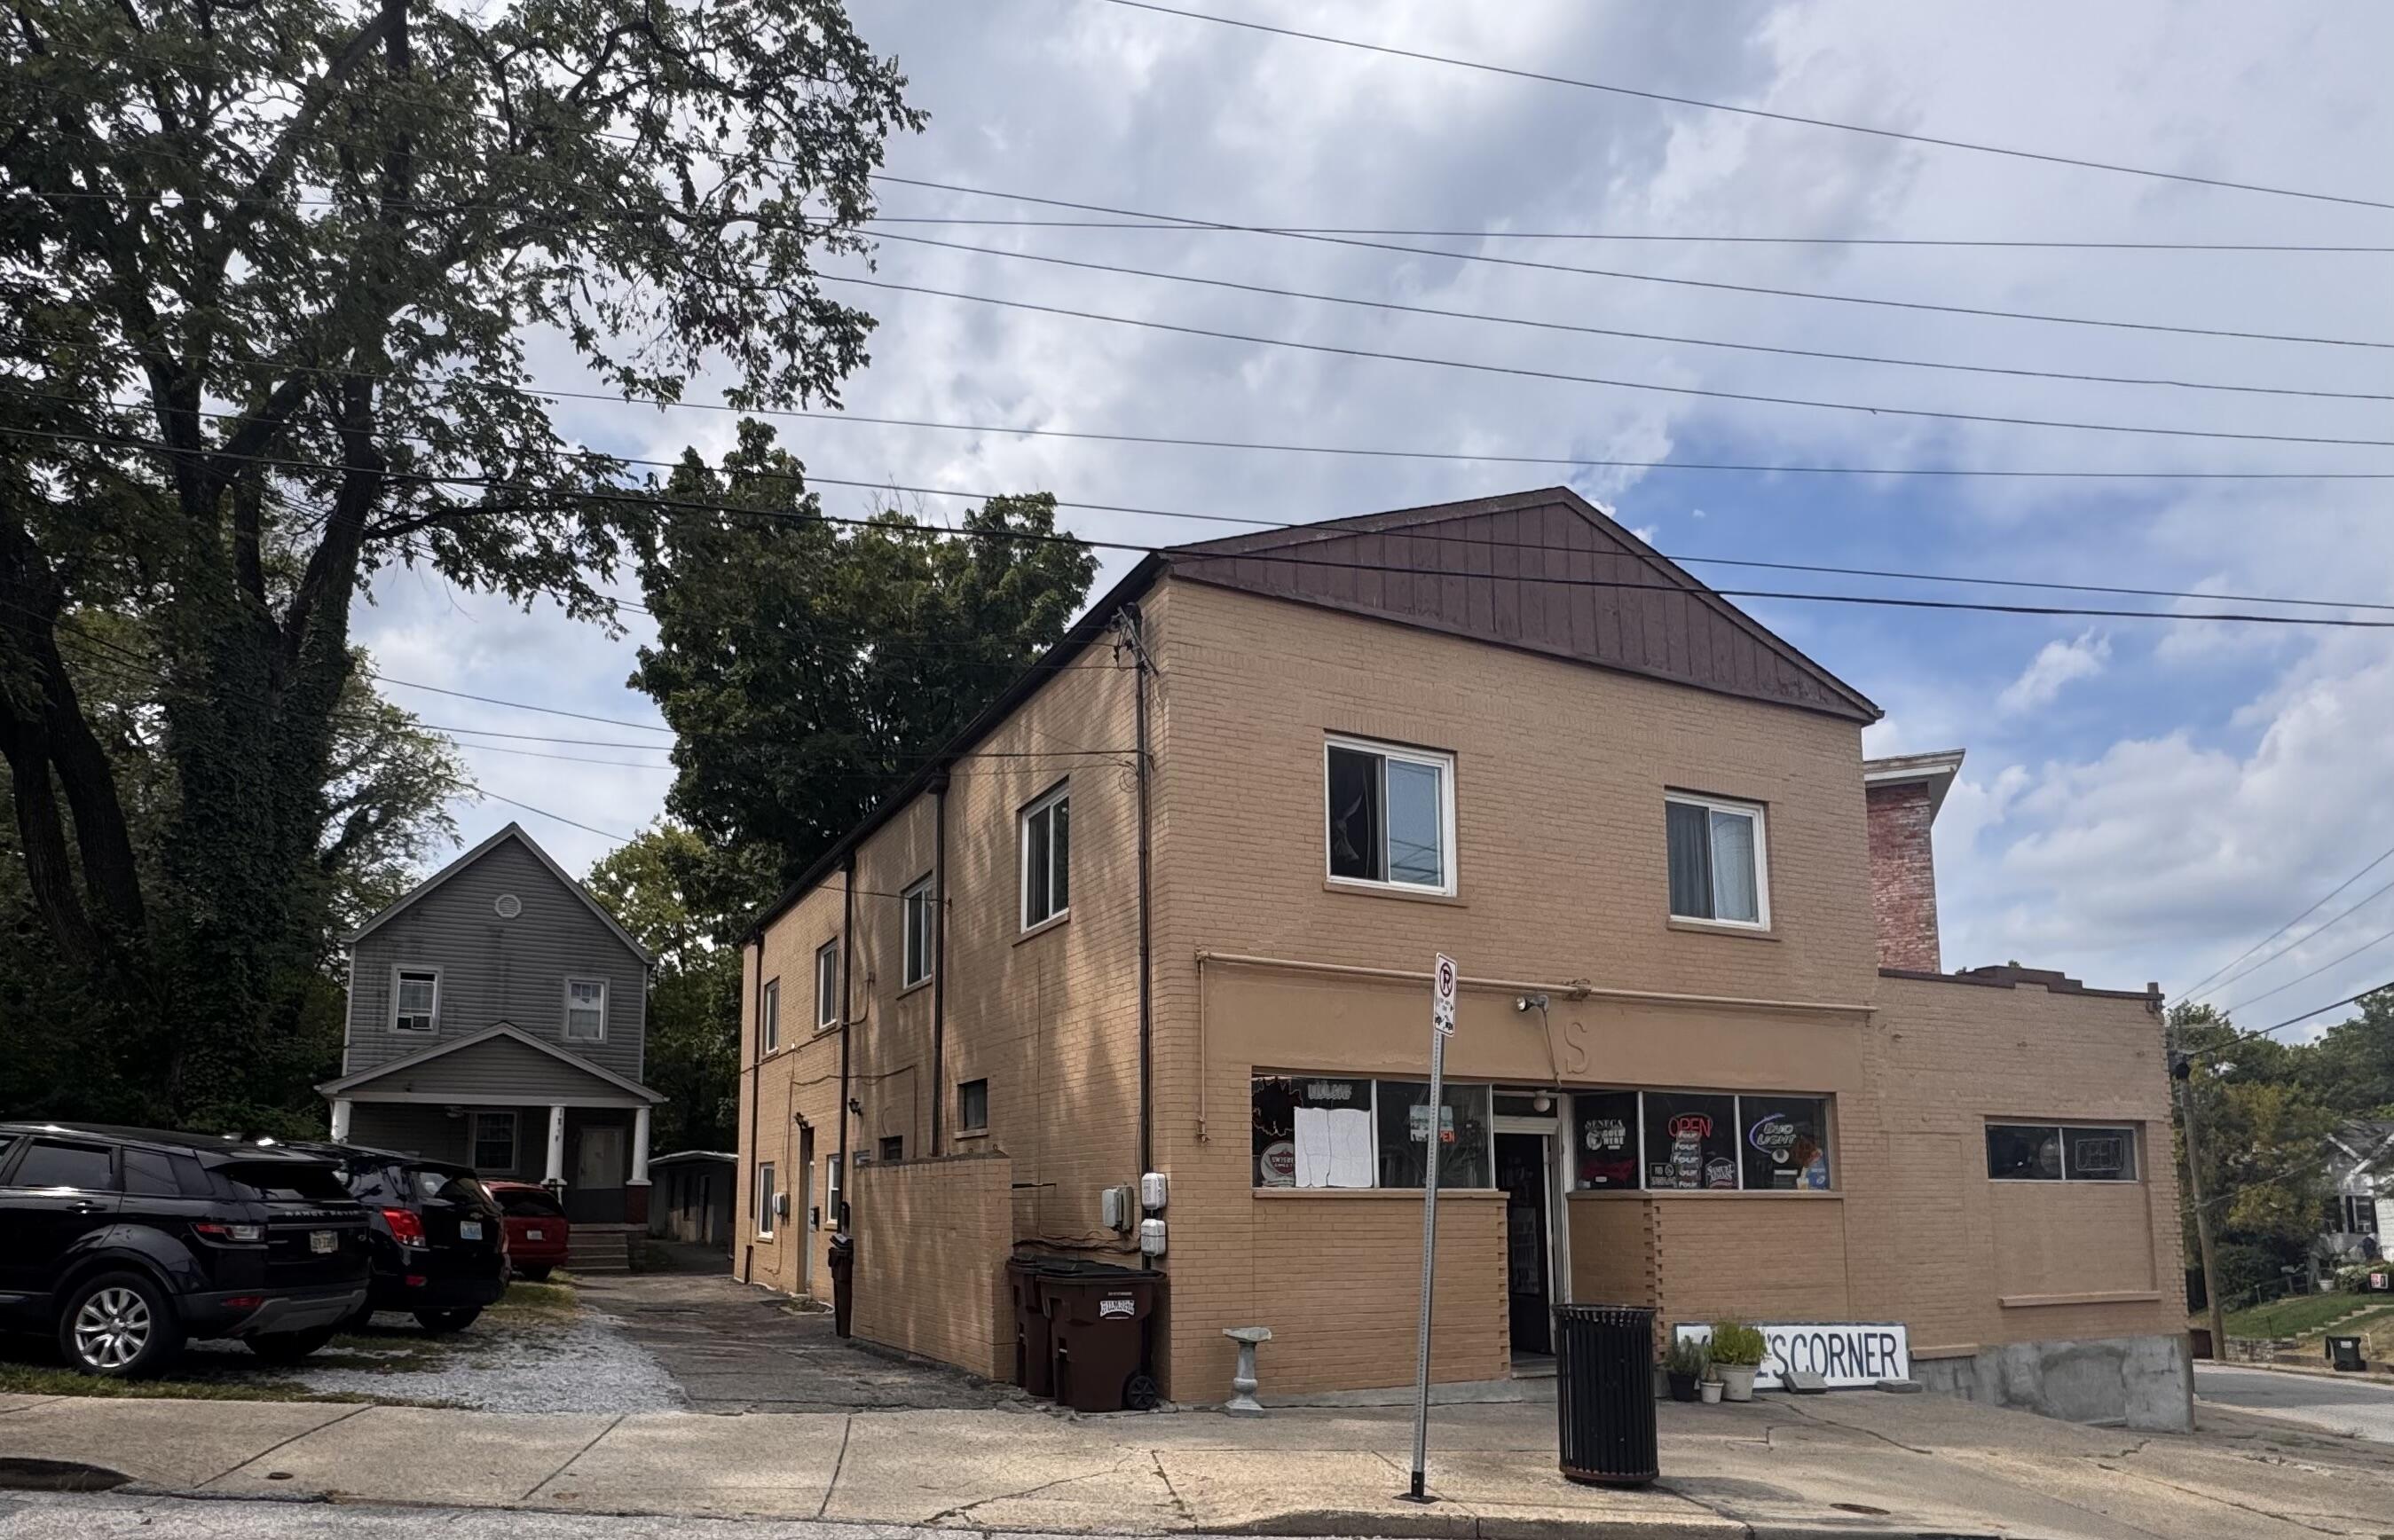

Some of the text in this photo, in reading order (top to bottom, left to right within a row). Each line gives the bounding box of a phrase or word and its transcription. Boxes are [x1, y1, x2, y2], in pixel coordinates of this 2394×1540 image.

[1668, 1117, 1711, 1138] OPEN
[1763, 1122, 1793, 1135] BUD
[1757, 1134, 1797, 1145] LIGHT
